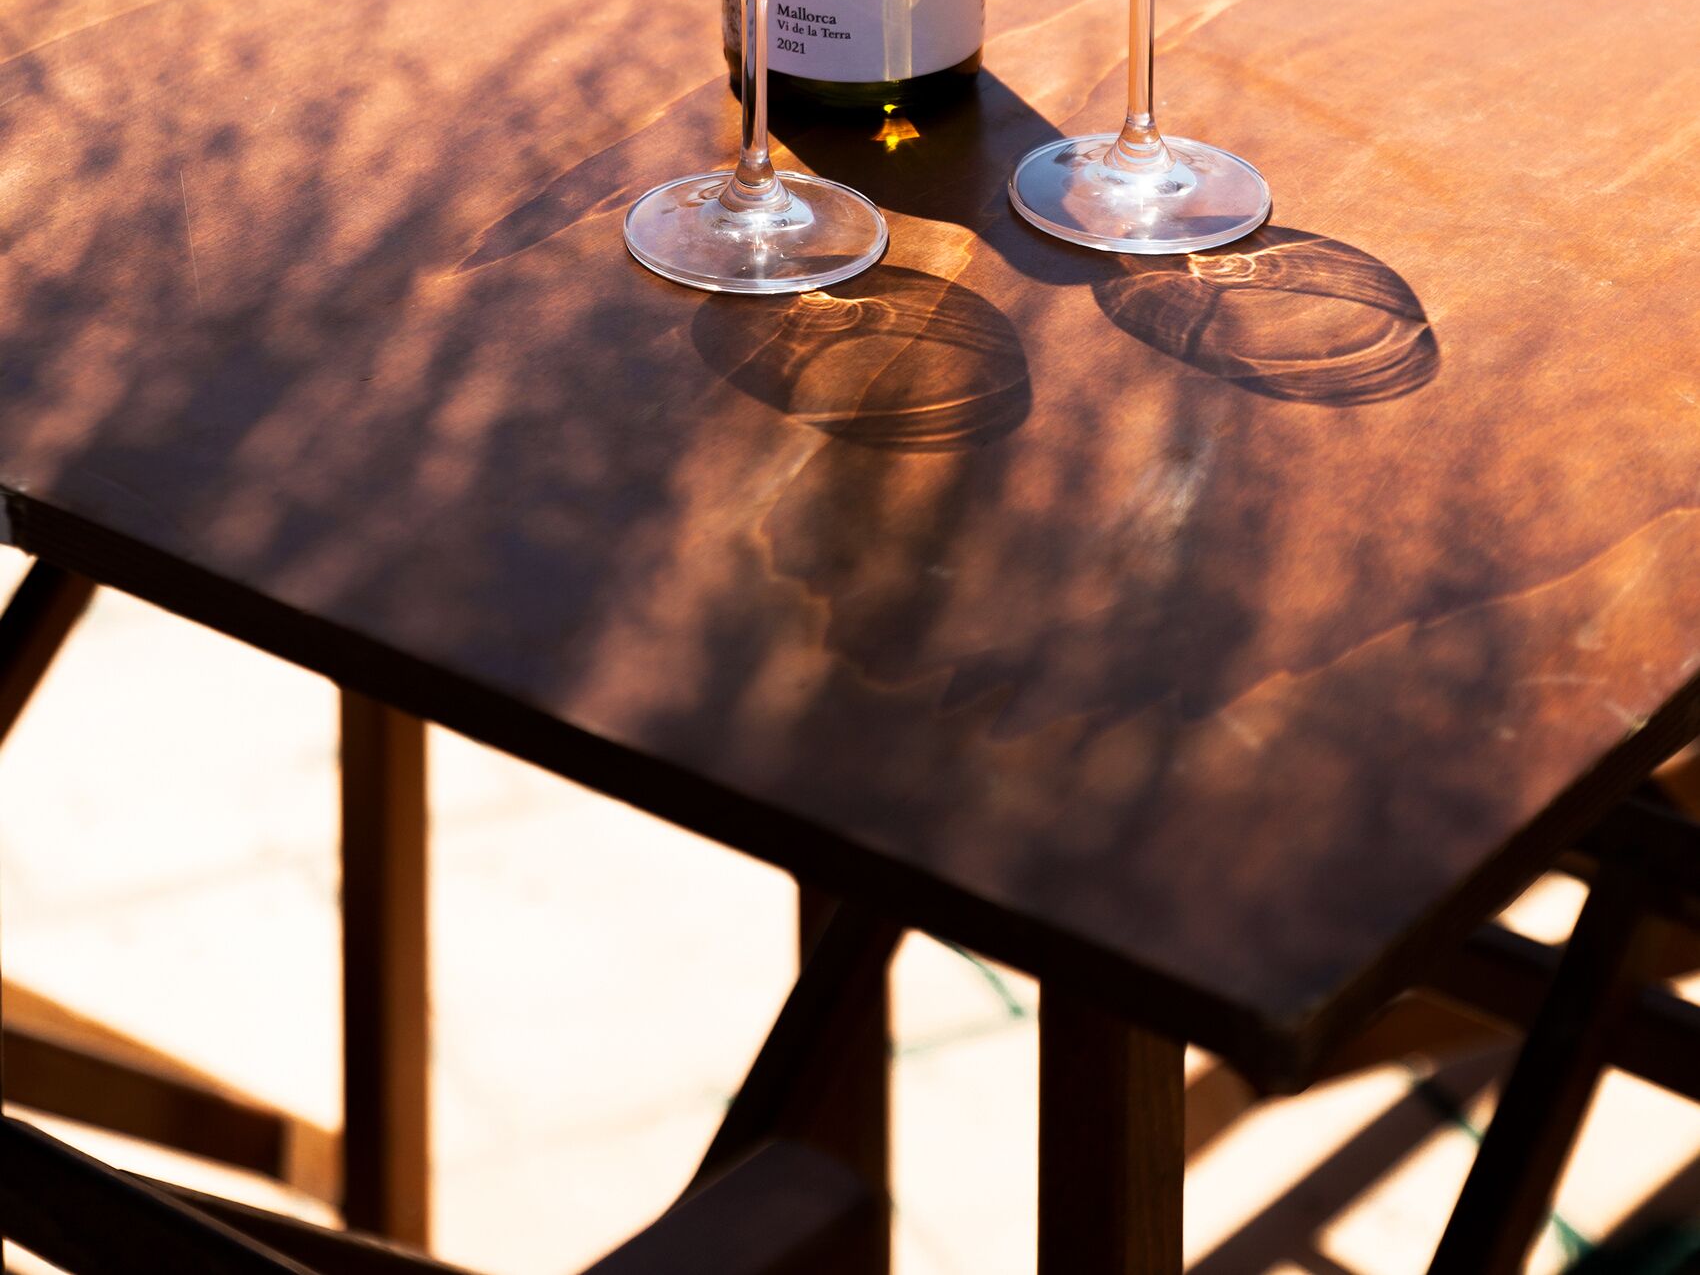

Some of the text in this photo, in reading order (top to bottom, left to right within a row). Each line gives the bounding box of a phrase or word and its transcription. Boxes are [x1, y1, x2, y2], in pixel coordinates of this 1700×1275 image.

[777, 3, 837, 25] Mallorca
[777, 19, 851, 40] Vi de la Terra
[777, 37, 806, 55] 2021
